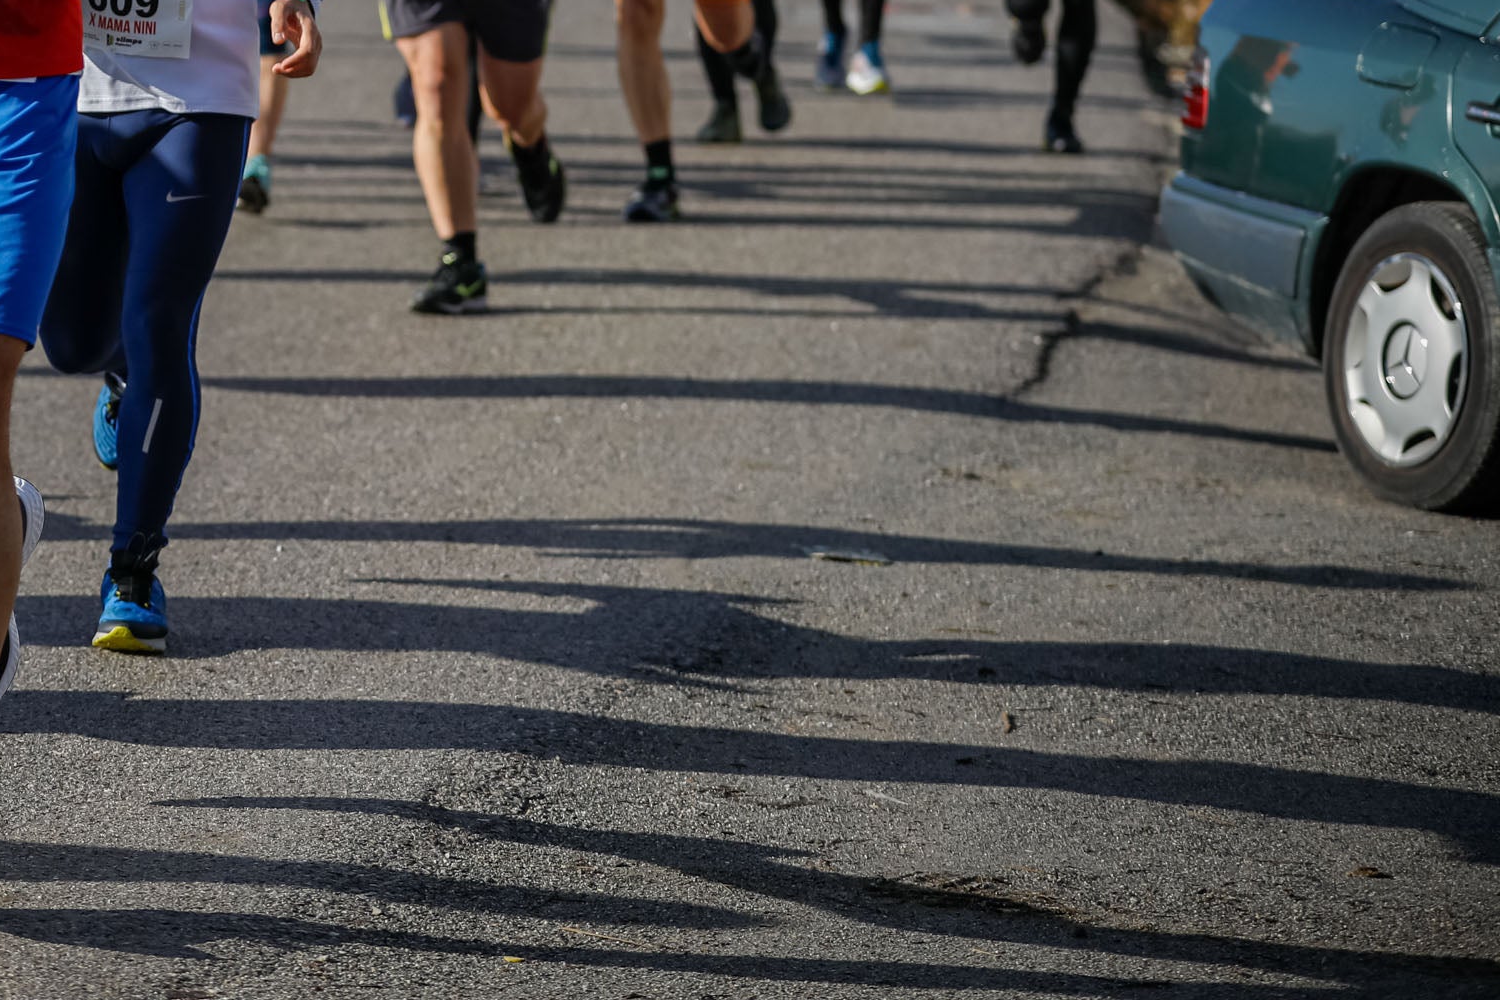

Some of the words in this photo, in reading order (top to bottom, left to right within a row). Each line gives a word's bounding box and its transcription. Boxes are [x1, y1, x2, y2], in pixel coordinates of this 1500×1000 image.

[89, 12, 97, 27] X
[98, 15, 131, 34] MAMA
[133, 20, 157, 35] NINI
